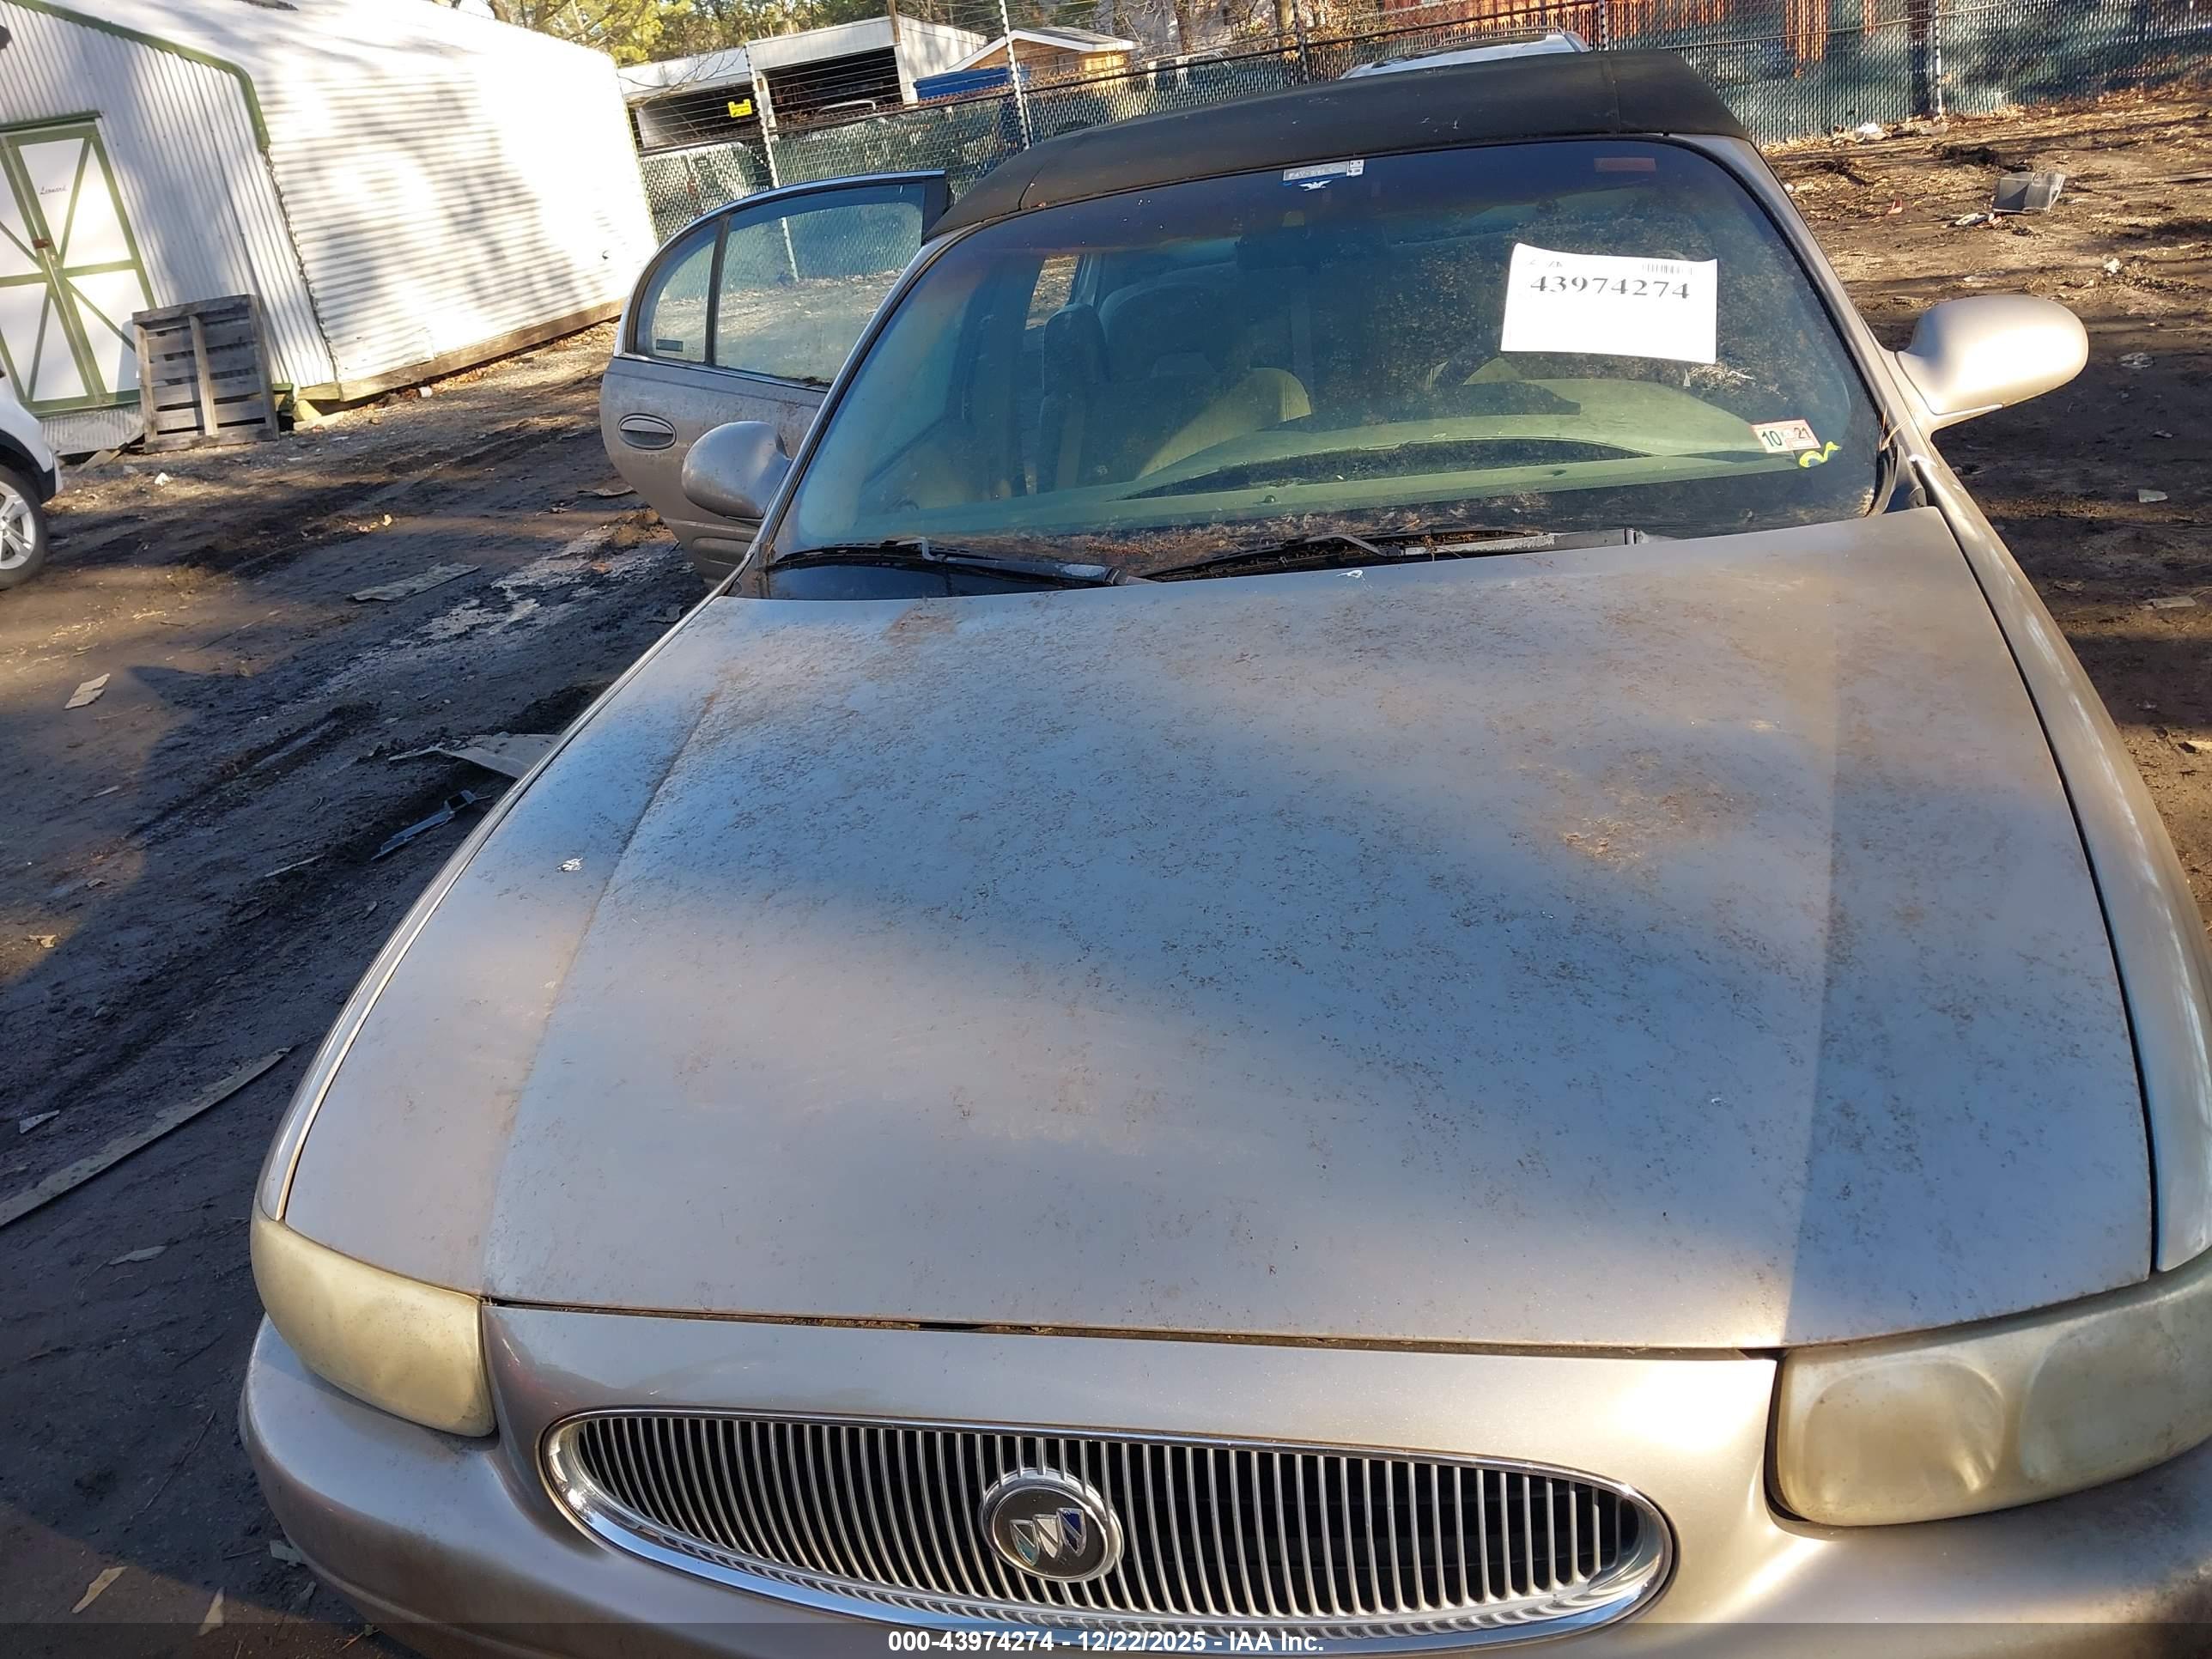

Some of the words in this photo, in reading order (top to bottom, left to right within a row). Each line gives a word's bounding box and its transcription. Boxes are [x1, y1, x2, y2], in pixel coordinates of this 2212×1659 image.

[1530, 276, 1689, 299] 43974274
[1762, 430, 1782, 447] 10
[1794, 427, 1811, 440] 21
